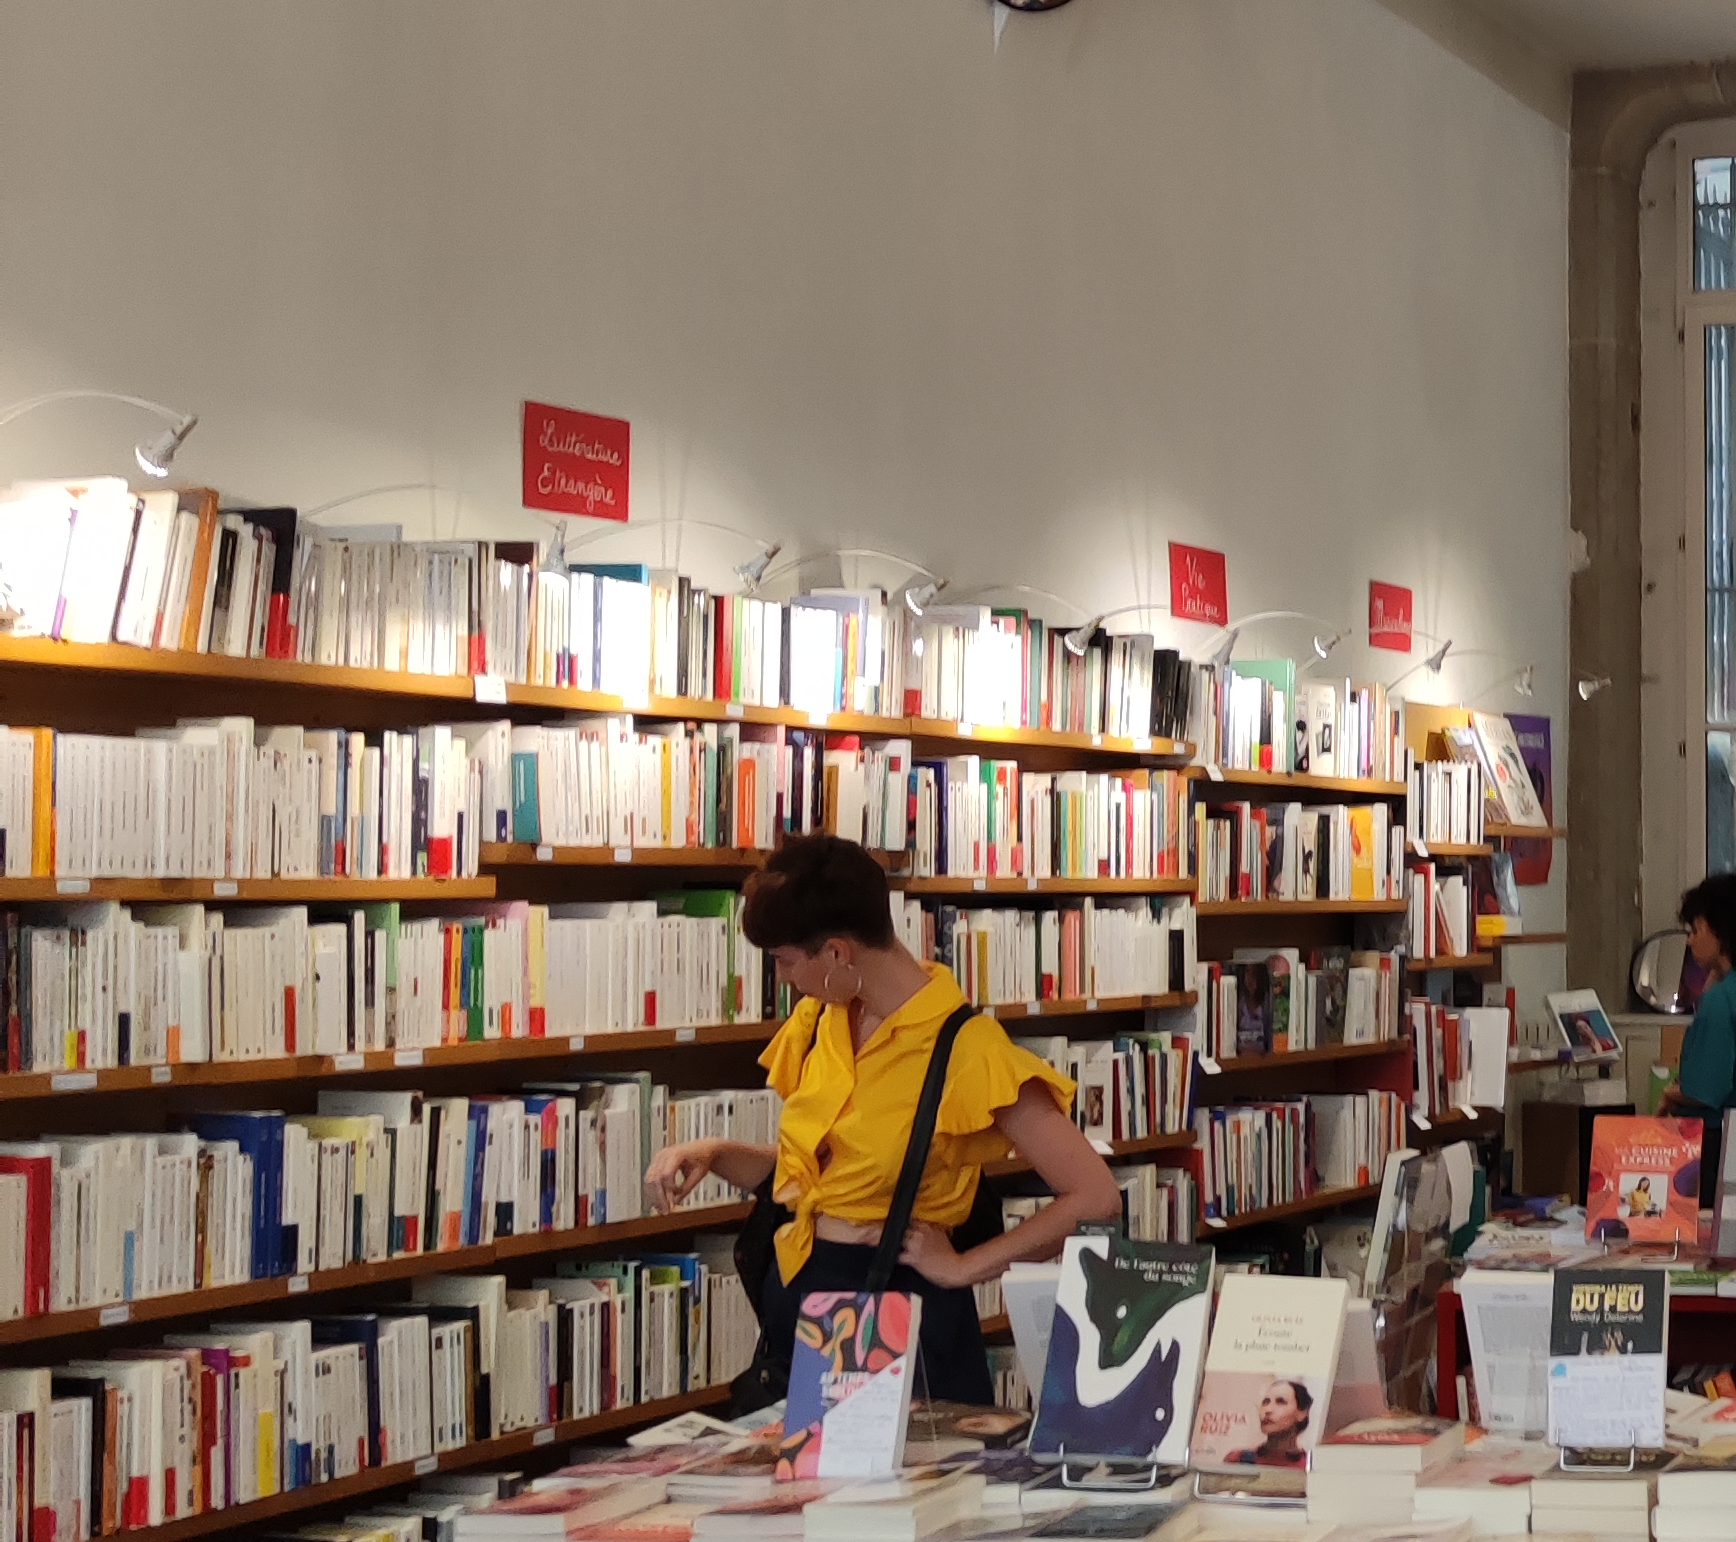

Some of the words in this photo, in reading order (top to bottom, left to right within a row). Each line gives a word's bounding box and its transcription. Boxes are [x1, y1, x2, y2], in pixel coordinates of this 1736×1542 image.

[539, 418, 622, 467] Littérature
[1631, 1146, 1679, 1158] CUISINE
[1570, 1291, 1601, 1312] DU
[1603, 1291, 1645, 1313] FEU
[1203, 1412, 1247, 1426] OLIVIA
[1200, 1422, 1231, 1437] RUIZ
